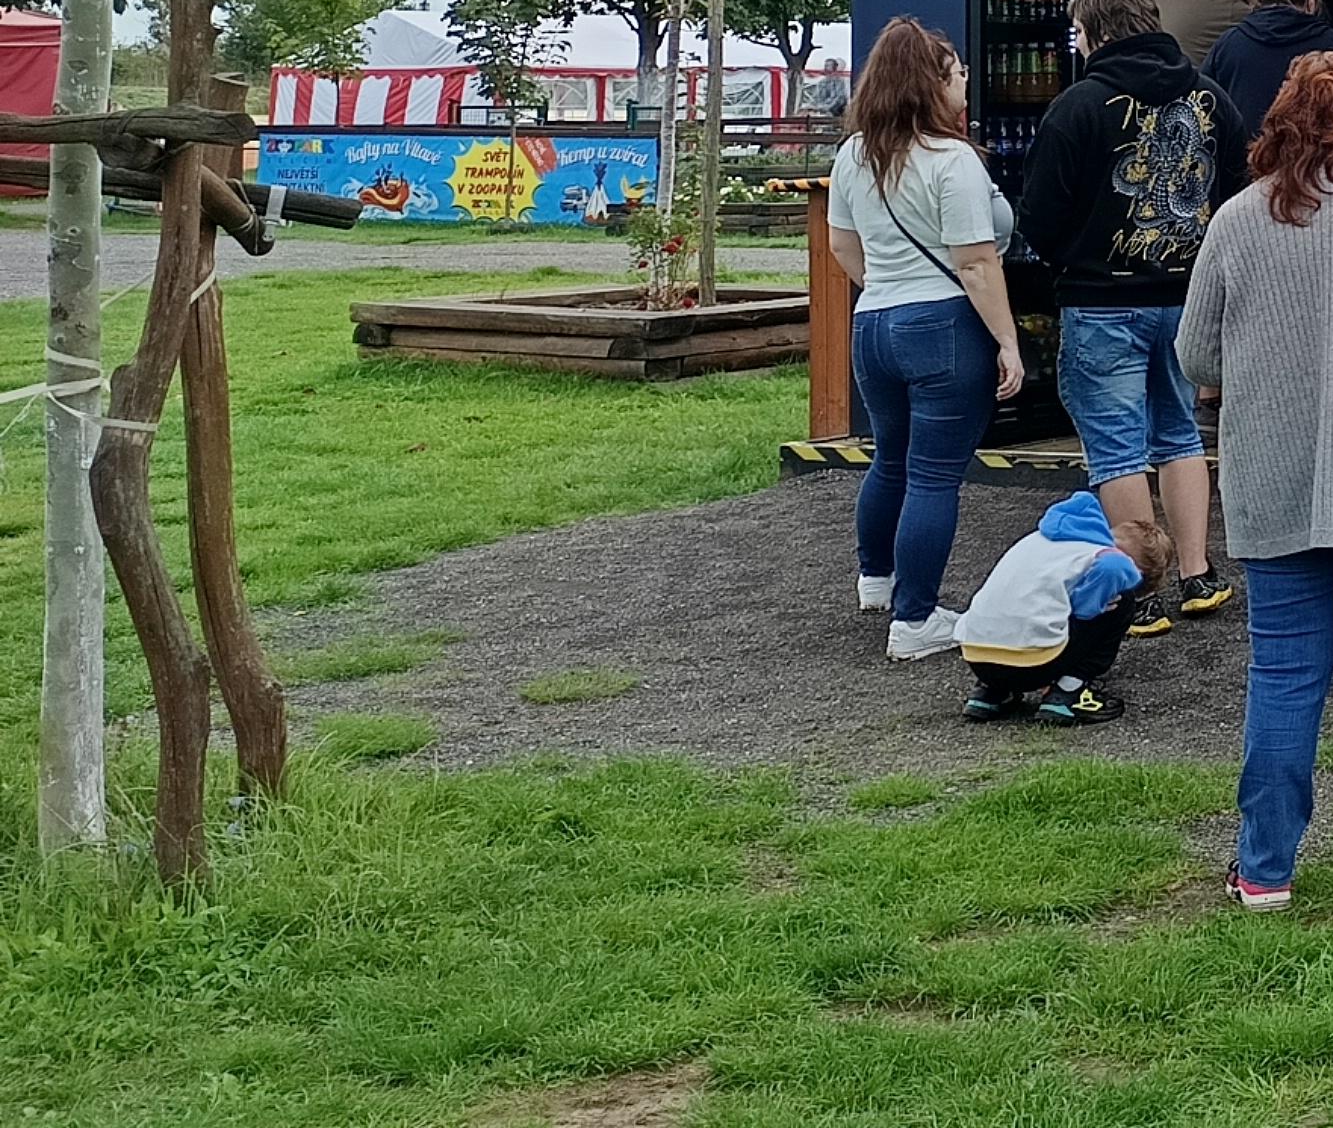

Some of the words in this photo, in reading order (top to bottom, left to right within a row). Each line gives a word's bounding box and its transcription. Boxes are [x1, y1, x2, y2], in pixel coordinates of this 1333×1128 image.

[345, 140, 380, 164] Rafty
[382, 143, 400, 155] na
[482, 148, 509, 163] SVĚT
[597, 147, 608, 159] u
[464, 164, 525, 179] TRAMPOÍN
[457, 183, 465, 194] V
